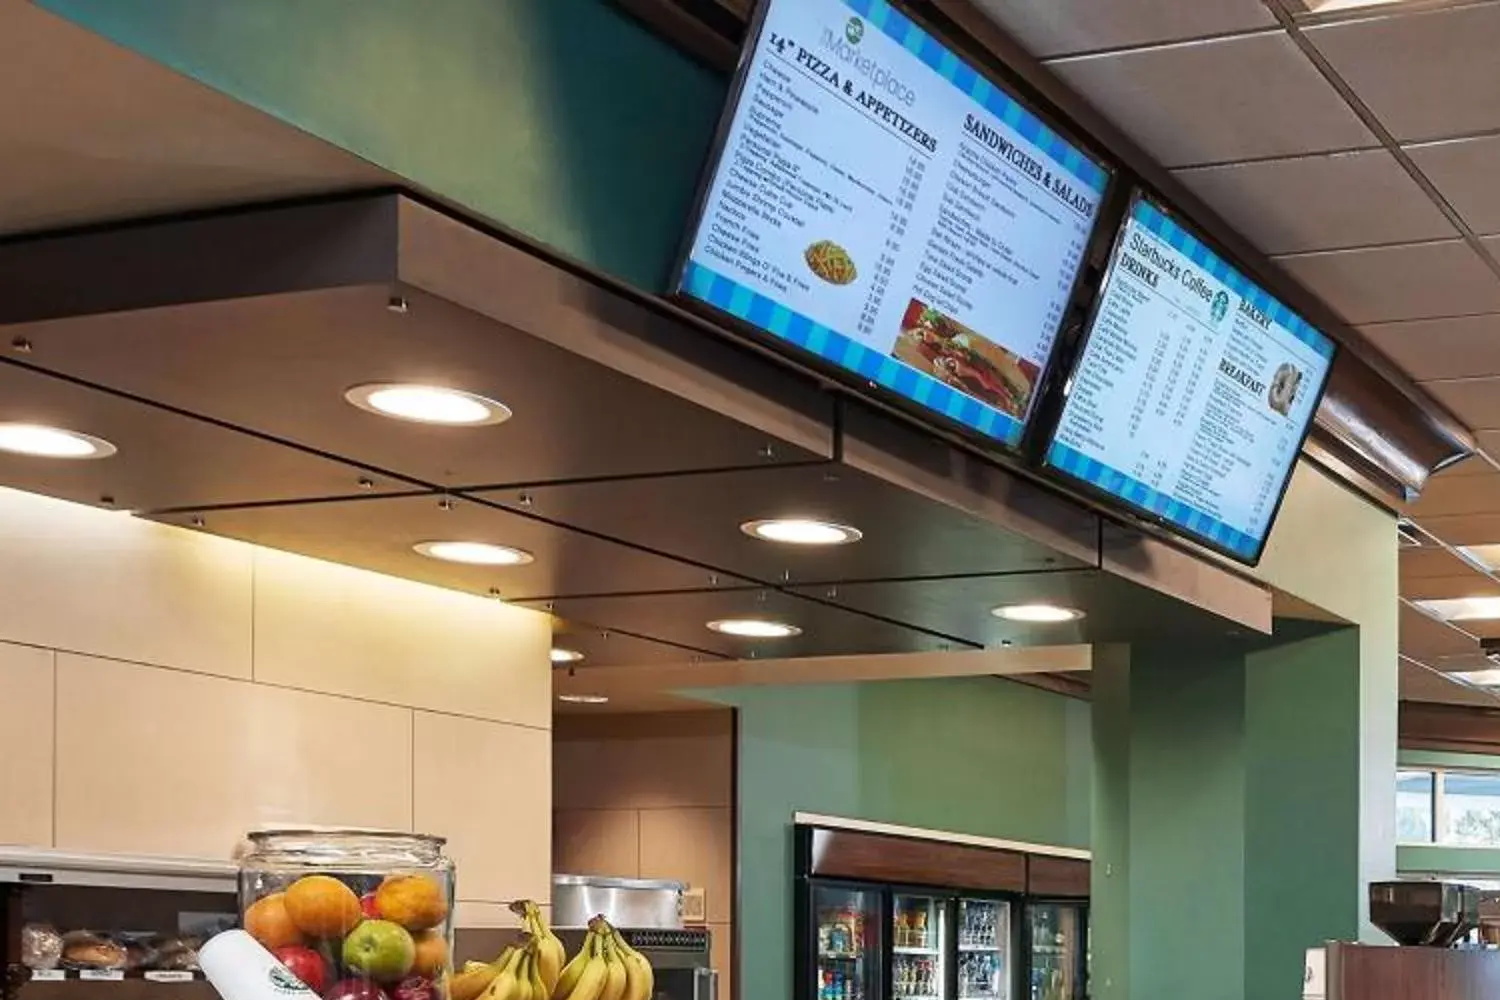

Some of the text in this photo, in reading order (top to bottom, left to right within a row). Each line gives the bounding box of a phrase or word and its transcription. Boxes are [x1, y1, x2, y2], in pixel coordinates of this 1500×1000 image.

[768, 33, 938, 153] 14" PIZZA & APPETIZERS
[963, 113, 1043, 180] SANDWICHES
[1043, 172, 1052, 188] &
[1119, 253, 1160, 287] DRINKS
[1129, 233, 1182, 281] Starbucks
[1181, 269, 1213, 303] Coffee
[1238, 299, 1273, 330] BAKERY
[1218, 358, 1266, 395] BREAKFAST
